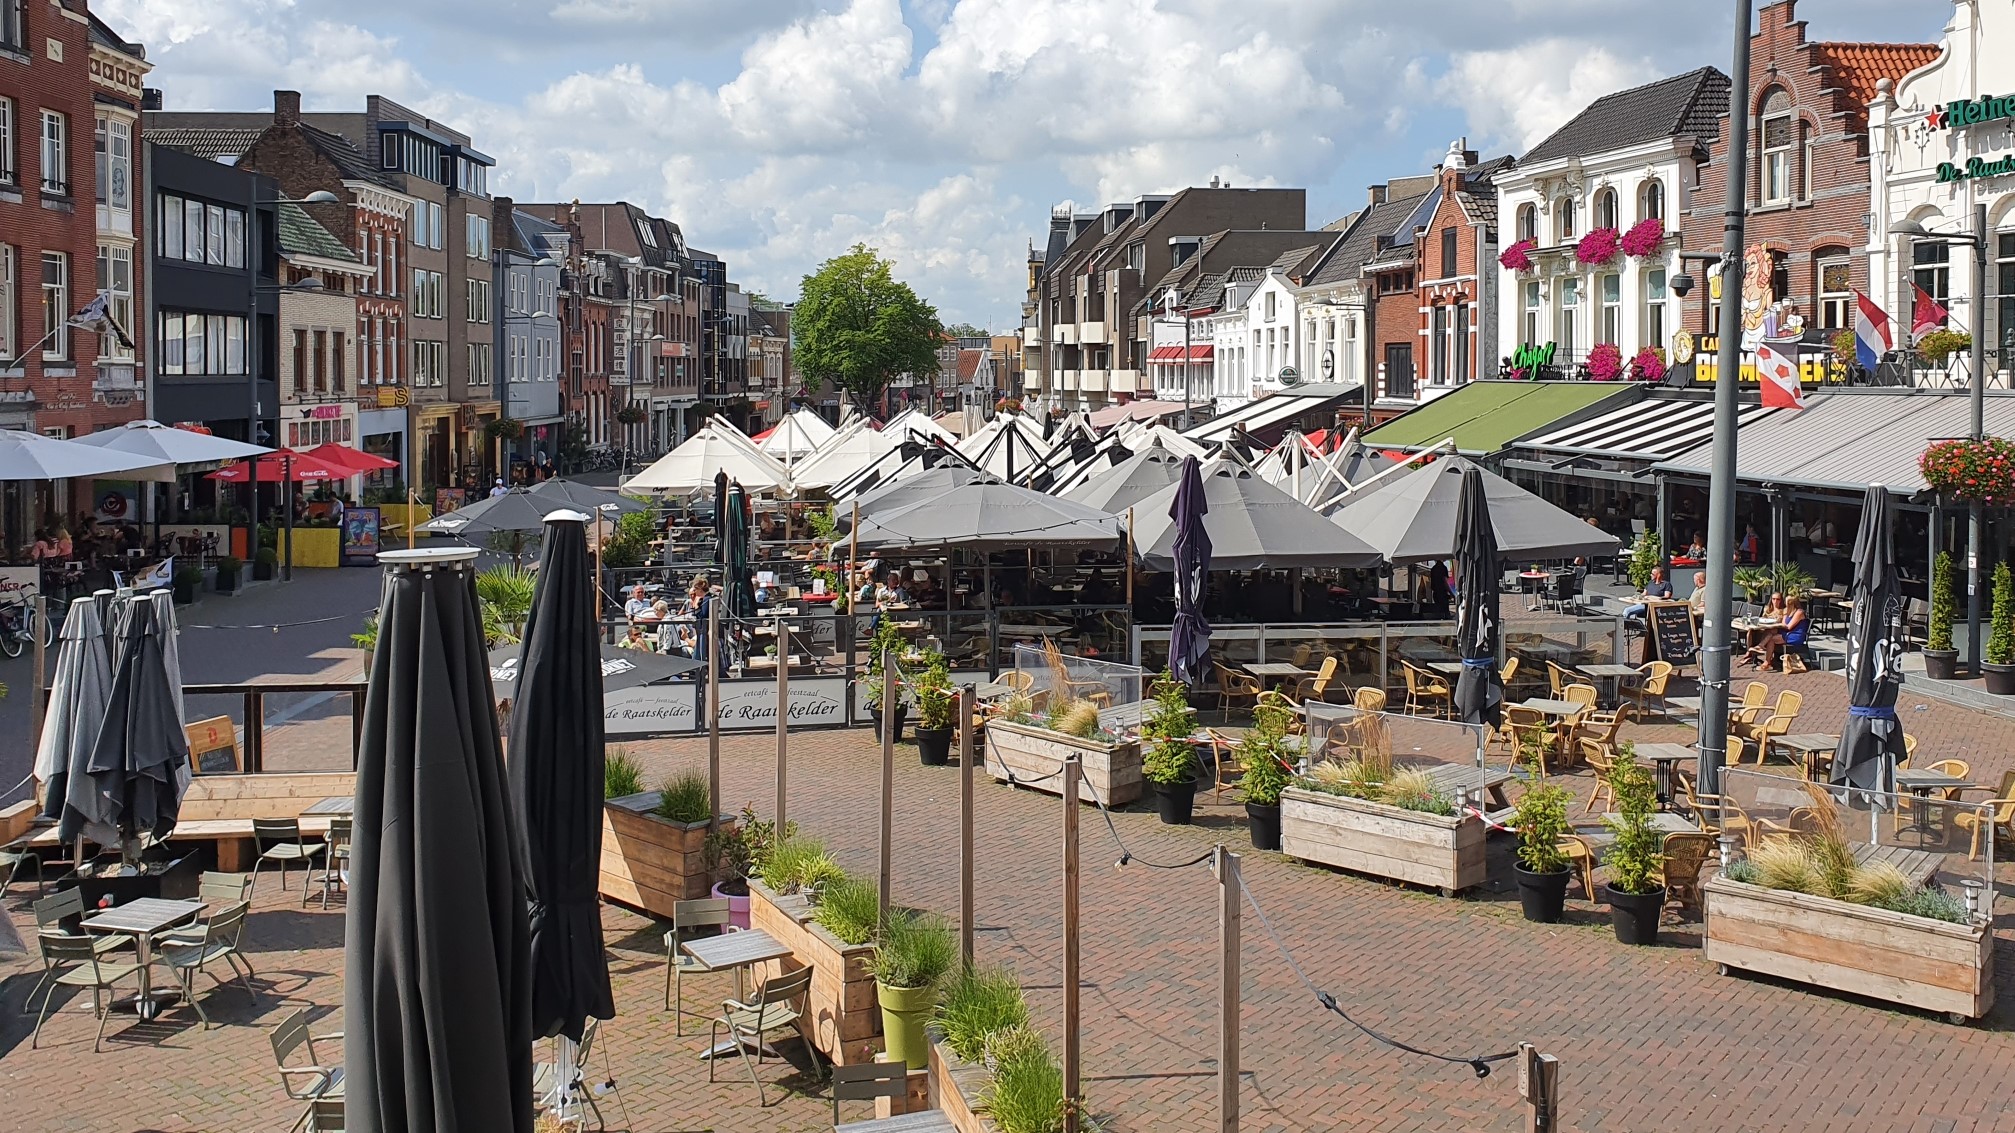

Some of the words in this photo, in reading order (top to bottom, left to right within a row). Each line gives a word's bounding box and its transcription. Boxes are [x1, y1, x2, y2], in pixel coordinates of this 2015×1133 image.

[1936, 162, 1959, 183] De
[1701, 337, 1719, 351] CA
[743, 688, 768, 698] eetcafé
[787, 689, 820, 697] feestzaal
[605, 709, 618, 719] de
[623, 706, 692, 719] Raatskelder
[739, 701, 839, 720] Raatkelder
